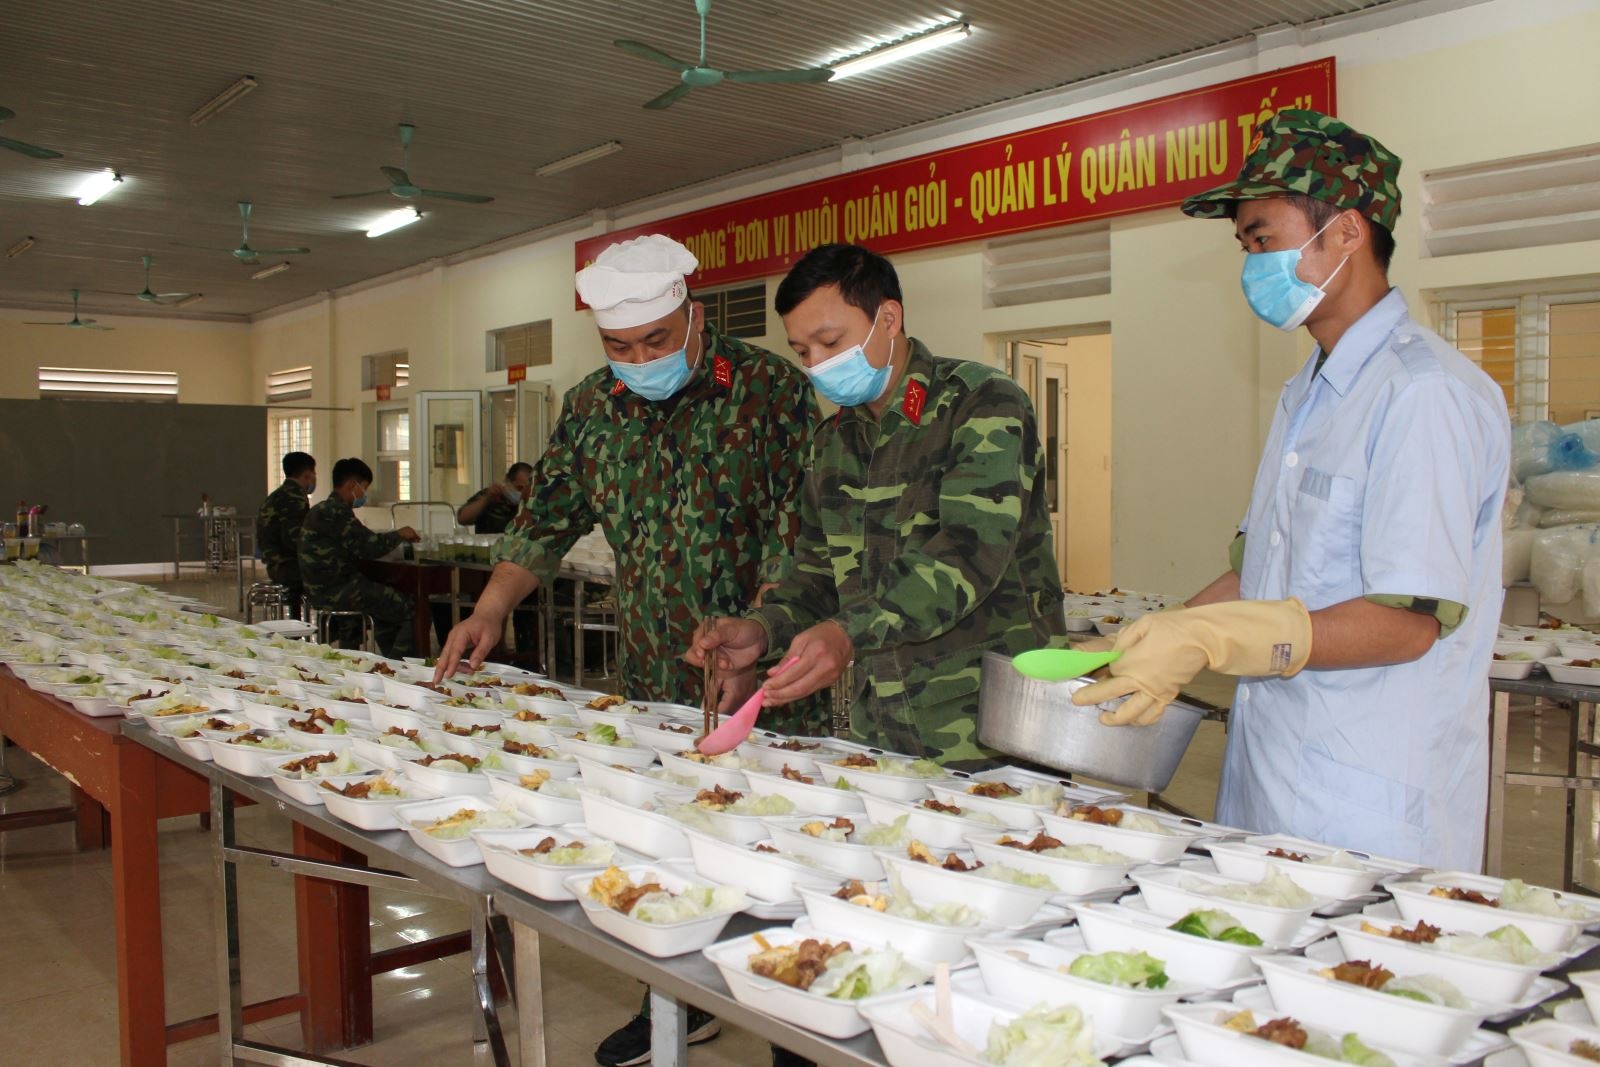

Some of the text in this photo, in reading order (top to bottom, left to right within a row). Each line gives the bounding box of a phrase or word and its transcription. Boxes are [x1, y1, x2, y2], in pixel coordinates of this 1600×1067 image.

[773, 214, 789, 264] VỊ
[795, 197, 838, 252] NUÔI
[844, 185, 897, 244] QUÂN
[905, 162, 947, 232] GIỎI
[954, 197, 963, 208] -
[970, 144, 1035, 223] QUẢN
[1043, 142, 1072, 207] LÝ
[1081, 128, 1155, 200] QUÂN
[1166, 119, 1227, 183] NHU
